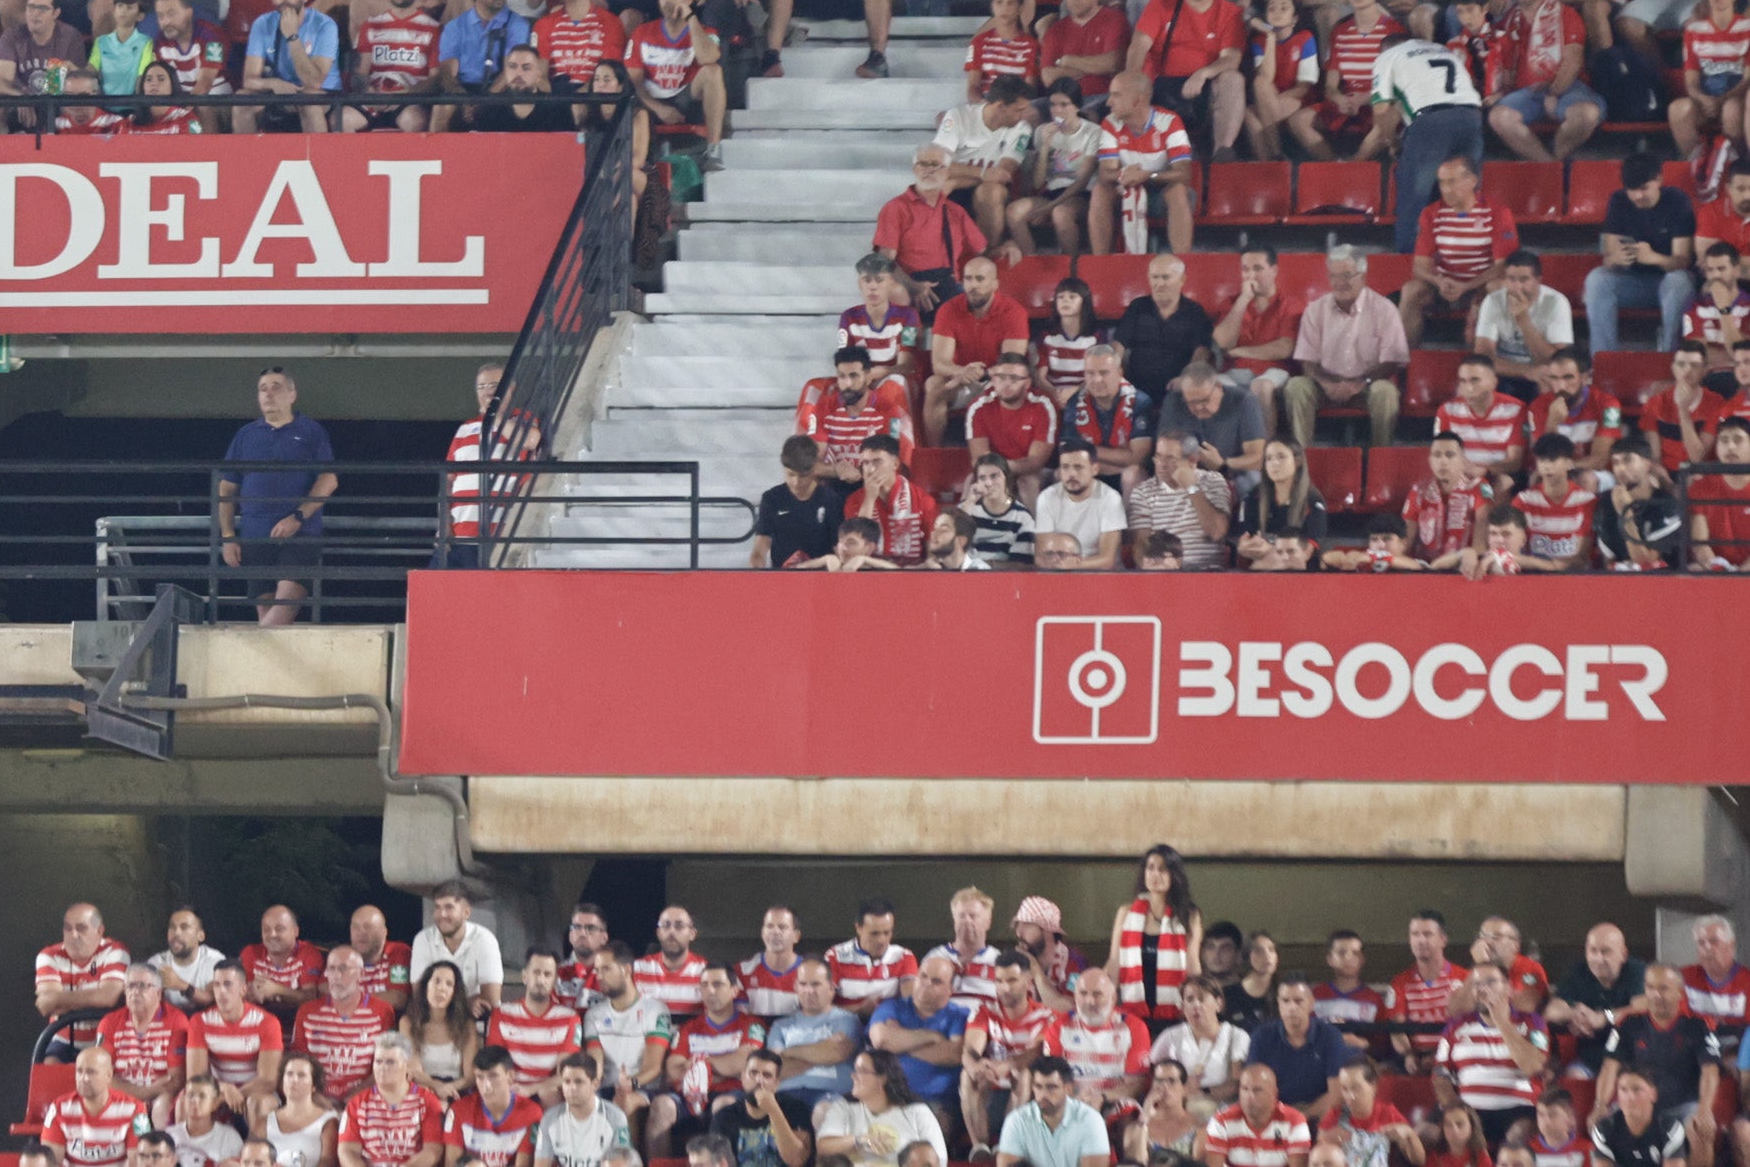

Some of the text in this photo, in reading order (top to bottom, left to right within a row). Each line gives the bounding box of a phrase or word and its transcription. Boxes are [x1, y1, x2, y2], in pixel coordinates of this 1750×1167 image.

[374, 46, 420, 63] Platzi
[1428, 59, 1456, 94] 7
[1177, 640, 1669, 723] BESOCCER
